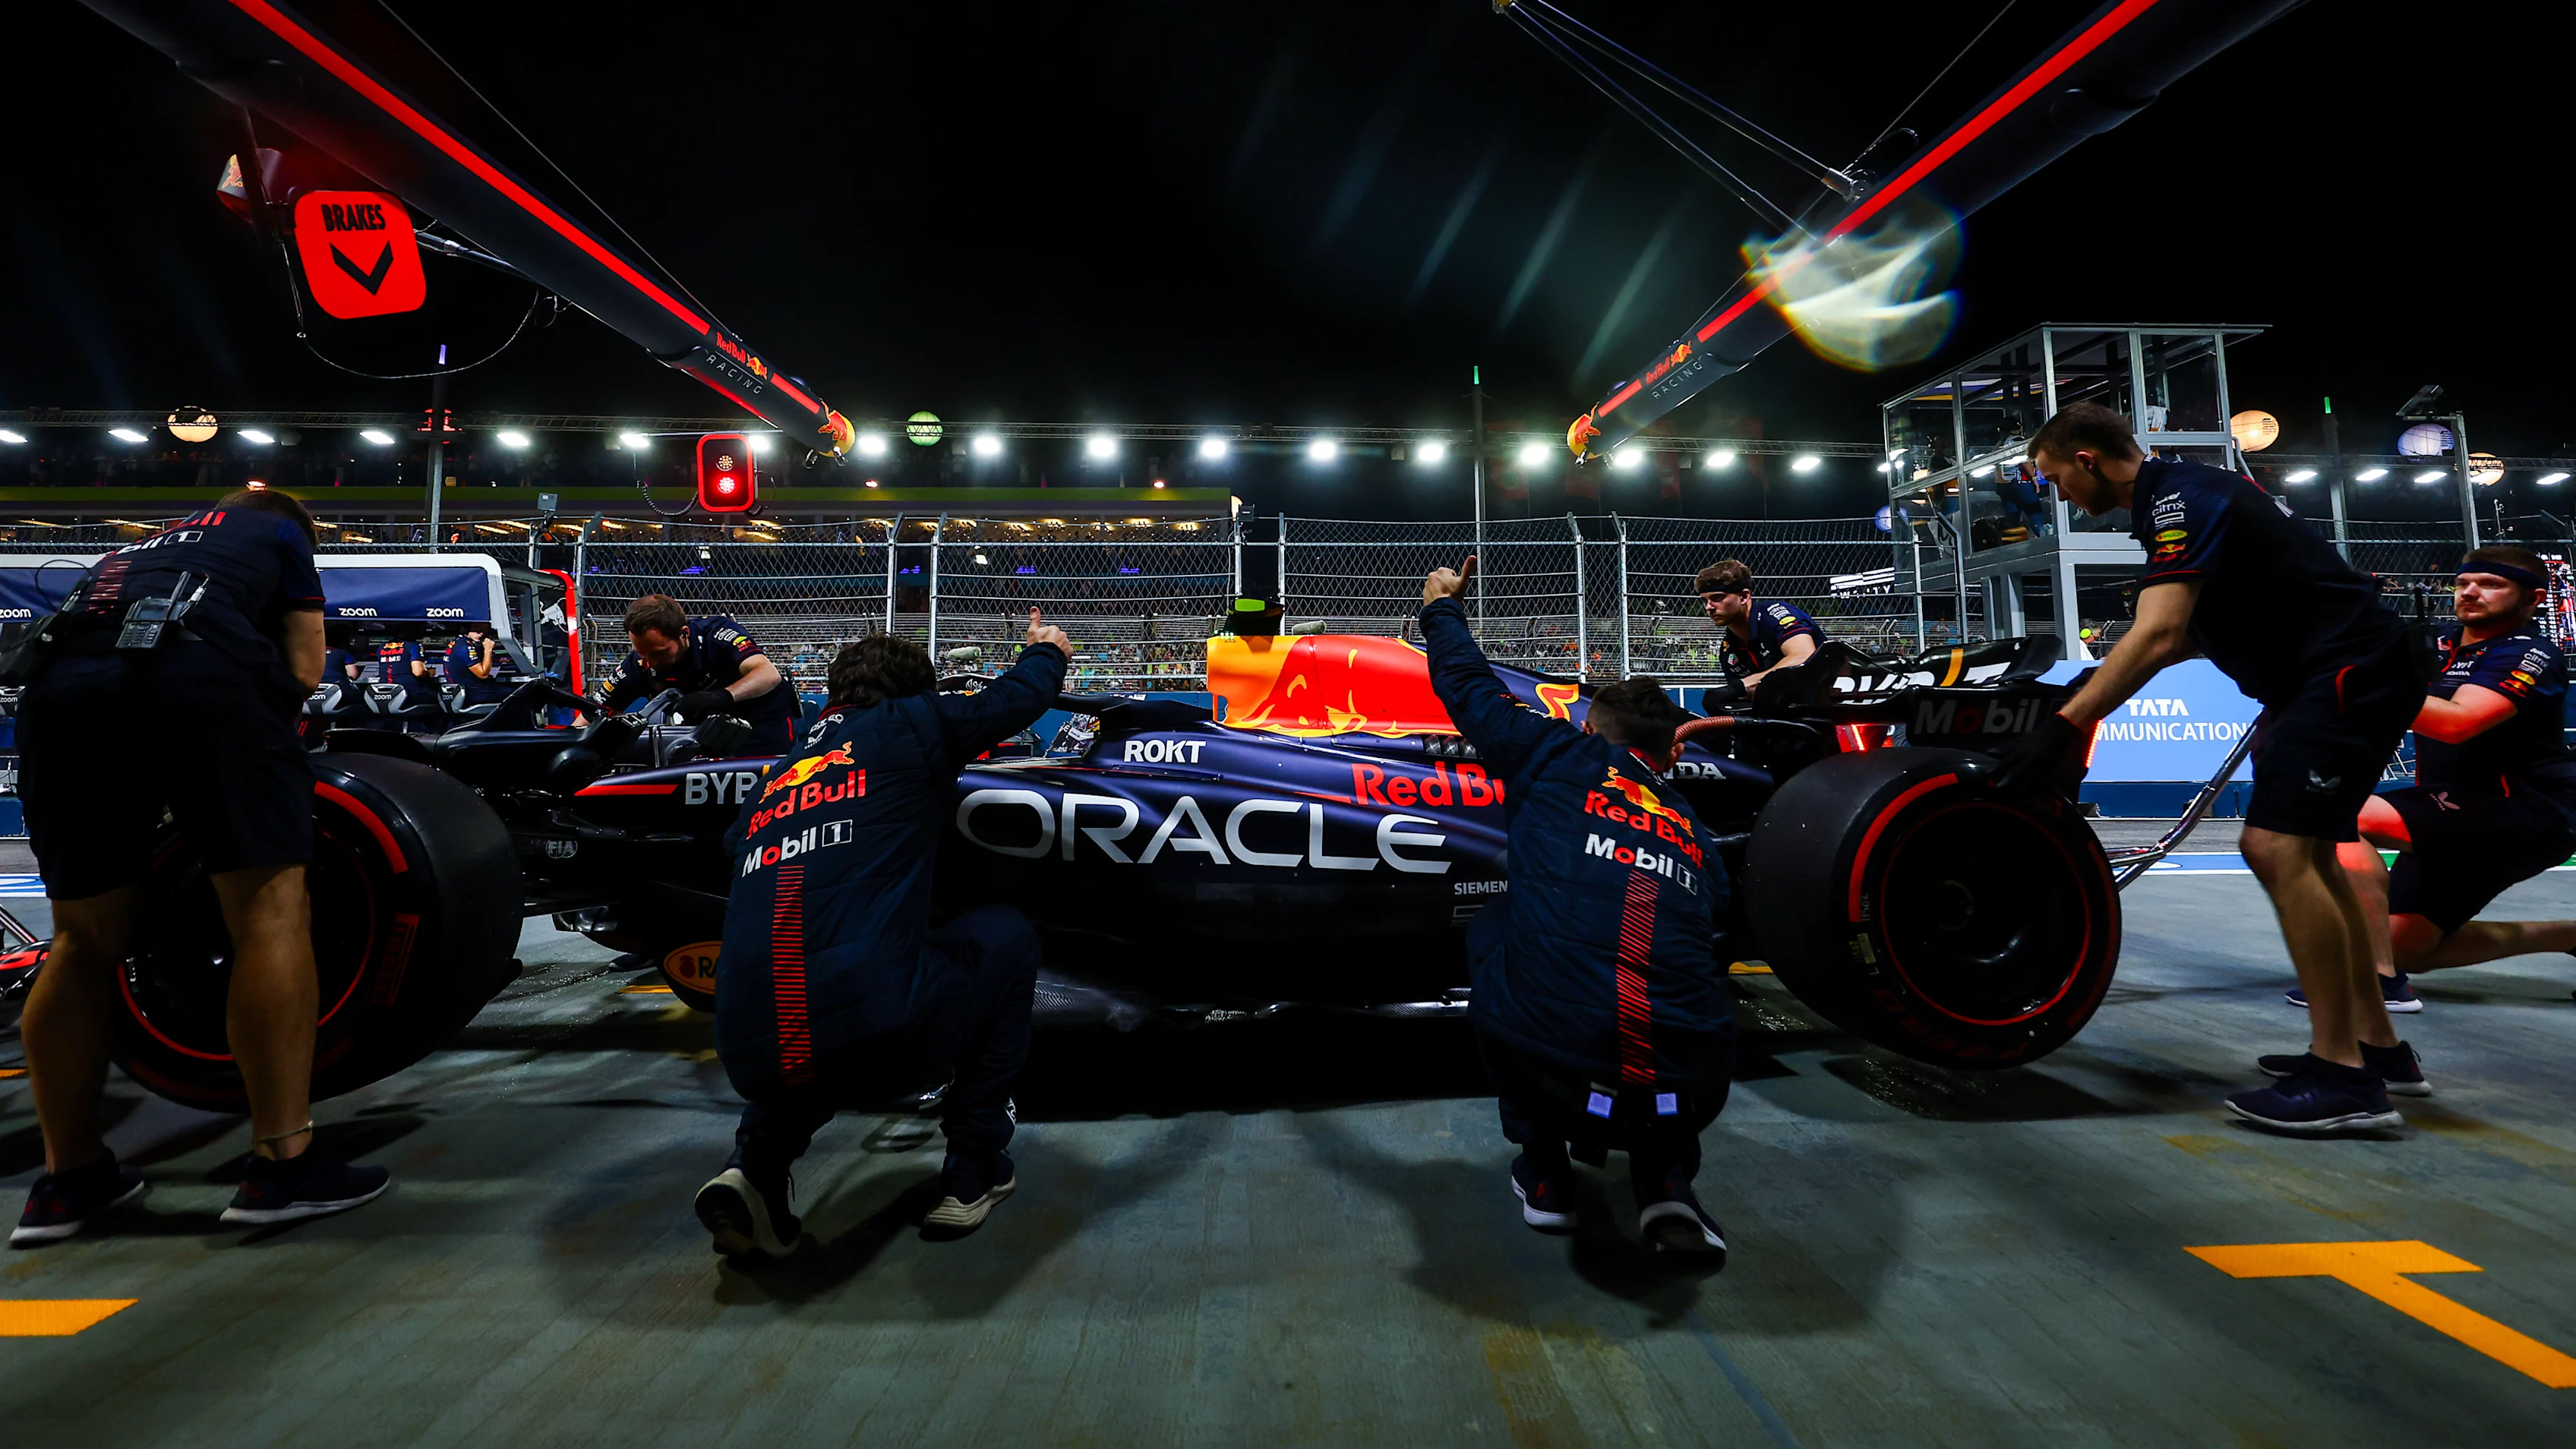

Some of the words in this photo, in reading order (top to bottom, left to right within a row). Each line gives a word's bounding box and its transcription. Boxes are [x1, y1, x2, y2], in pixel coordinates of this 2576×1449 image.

[320, 204, 386, 232] BRAKES
[706, 354, 763, 395] RACING
[1652, 361, 1703, 399] RACING
[339, 608, 377, 617] zoom
[426, 608, 464, 617] zoom
[1912, 698, 2041, 735] Mobil
[2124, 698, 2190, 717] TATA
[1123, 738, 1207, 764] ROKT
[1350, 761, 1454, 807] Red
[745, 788, 797, 841] Red
[800, 769, 867, 811] Bull
[955, 788, 1452, 874] ORACLE
[1583, 789, 1652, 832] Red
[1656, 816, 1703, 869] Bull
[741, 826, 817, 878] Mobil
[1584, 832, 1674, 879] Mobil
